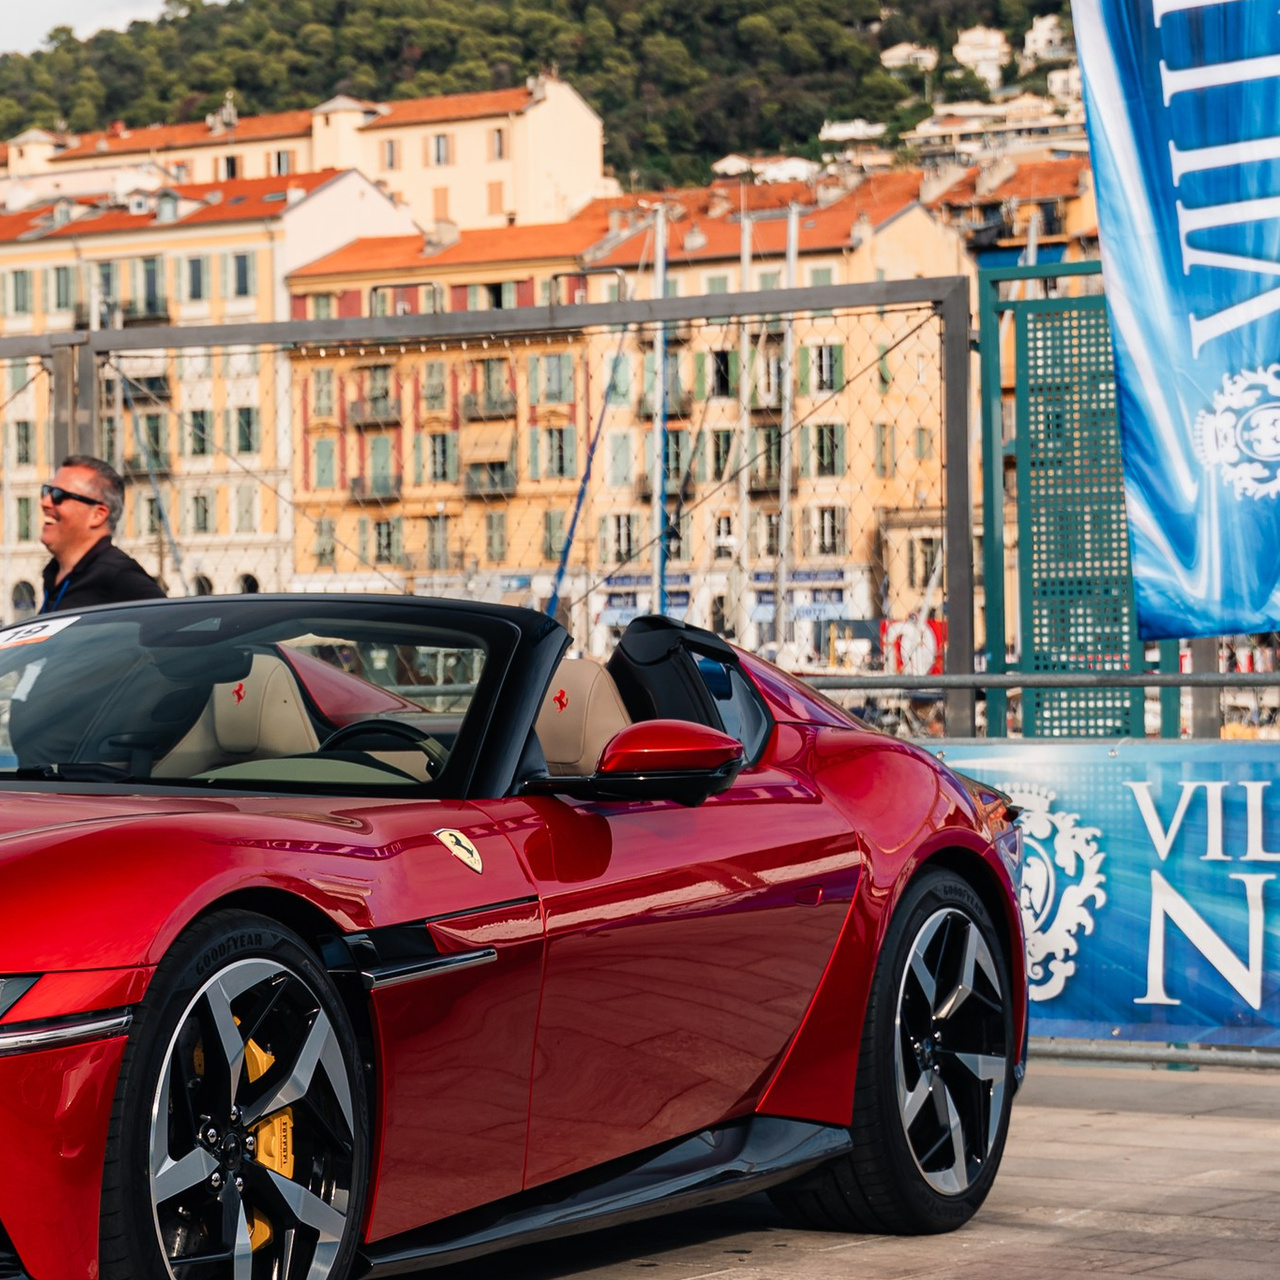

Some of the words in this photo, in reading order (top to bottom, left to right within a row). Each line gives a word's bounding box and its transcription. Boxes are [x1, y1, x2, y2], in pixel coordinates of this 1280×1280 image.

[3, 624, 50, 643] 19
[1122, 781, 1280, 862] VIL
[195, 932, 263, 976] GOODYEAR
[1133, 869, 1276, 1011] N
